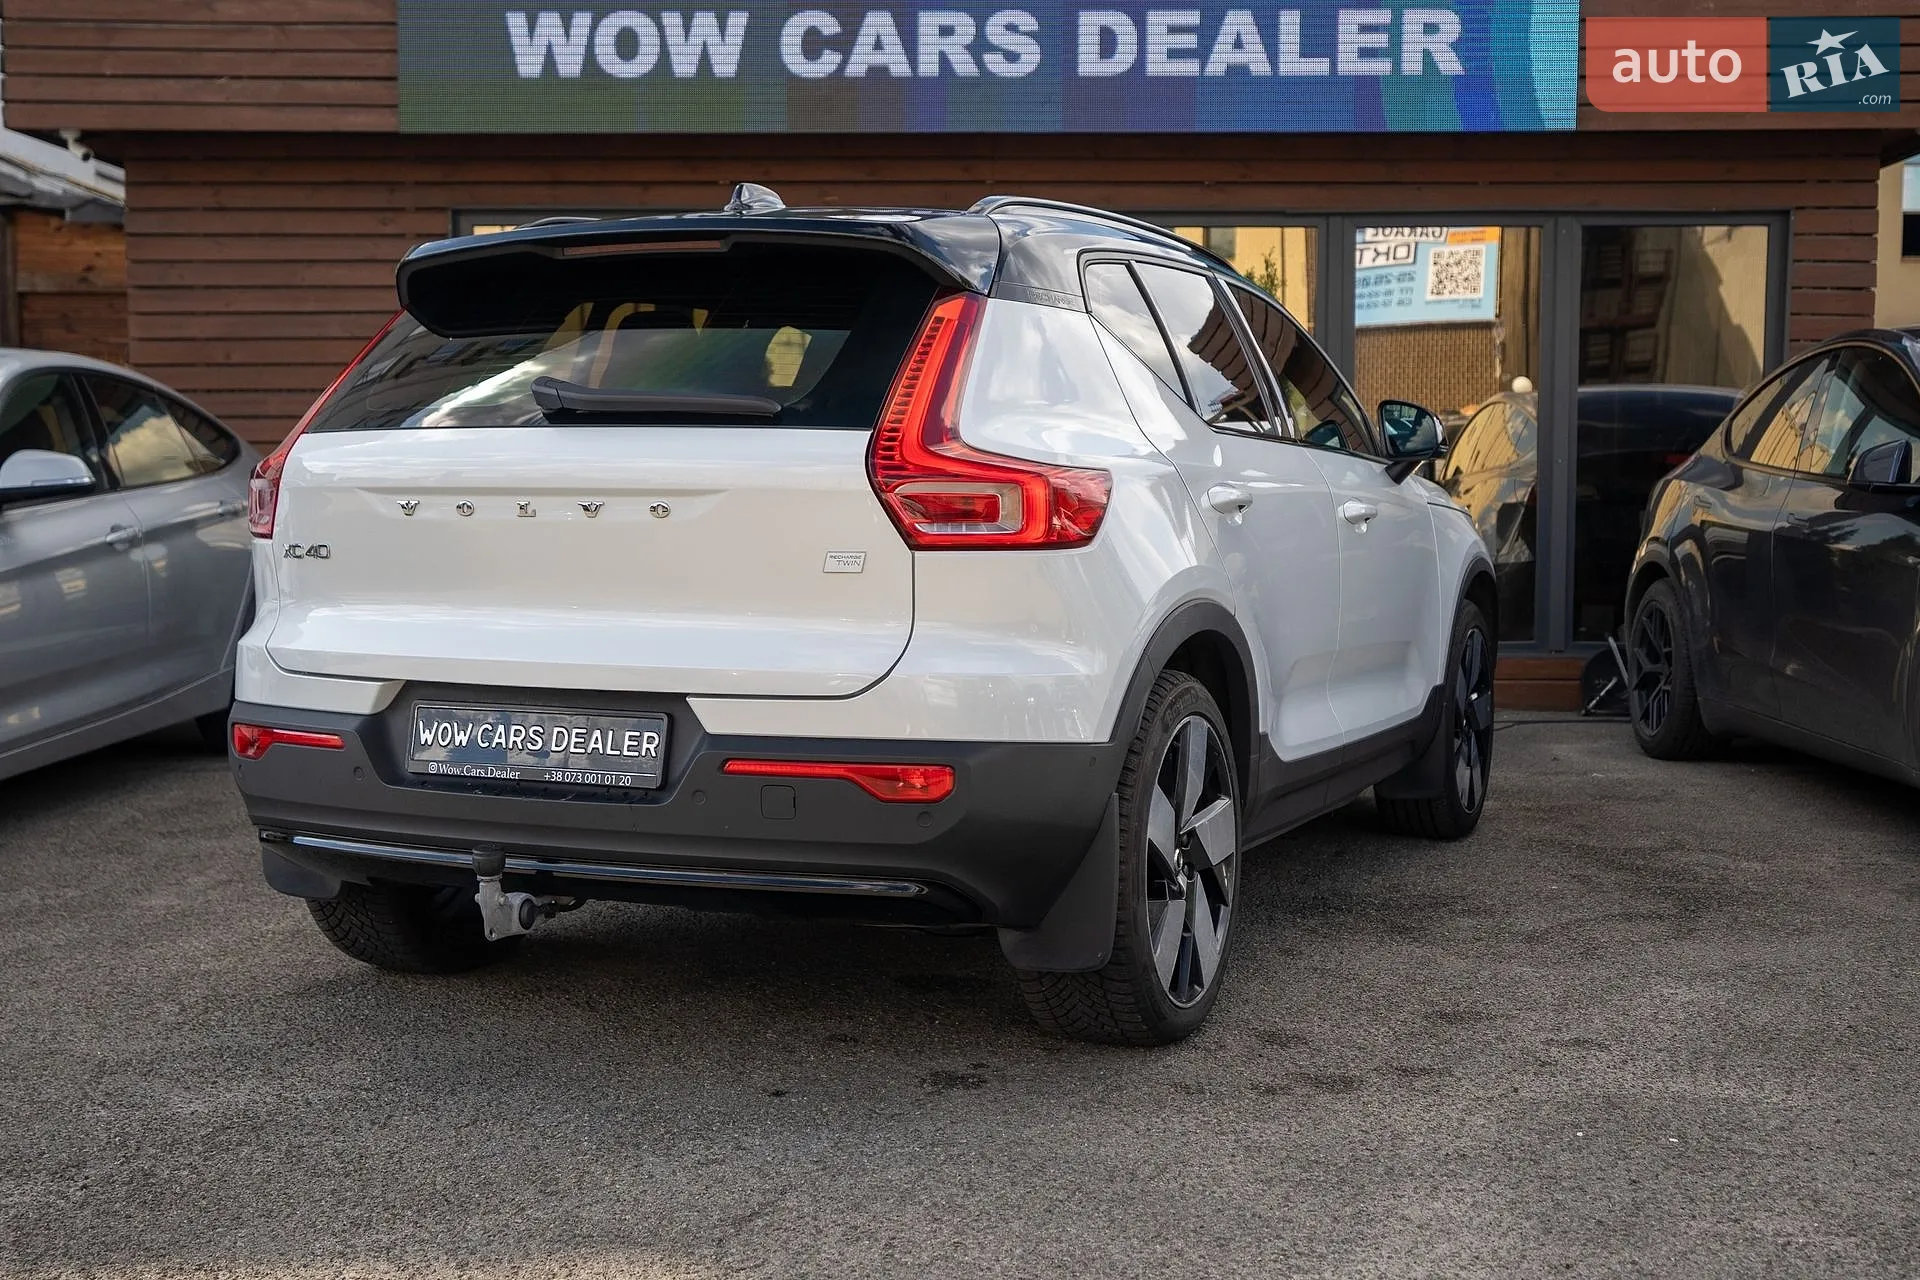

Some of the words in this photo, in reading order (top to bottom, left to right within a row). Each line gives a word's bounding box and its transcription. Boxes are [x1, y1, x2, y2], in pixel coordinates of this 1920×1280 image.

[505, 11, 750, 78] WOW
[780, 10, 1041, 78] CARS
[1077, 10, 1466, 76] DEALER
[397, 499, 671, 518] VOLVO
[418, 720, 474, 747] WOW
[477, 723, 544, 750] CARS
[551, 726, 660, 757] DEALER
[544, 771, 563, 781] +38
[564, 771, 582, 782] 073
[584, 773, 602, 784] 001
[604, 774, 617, 785] 01
[619, 775, 632, 786] 20
